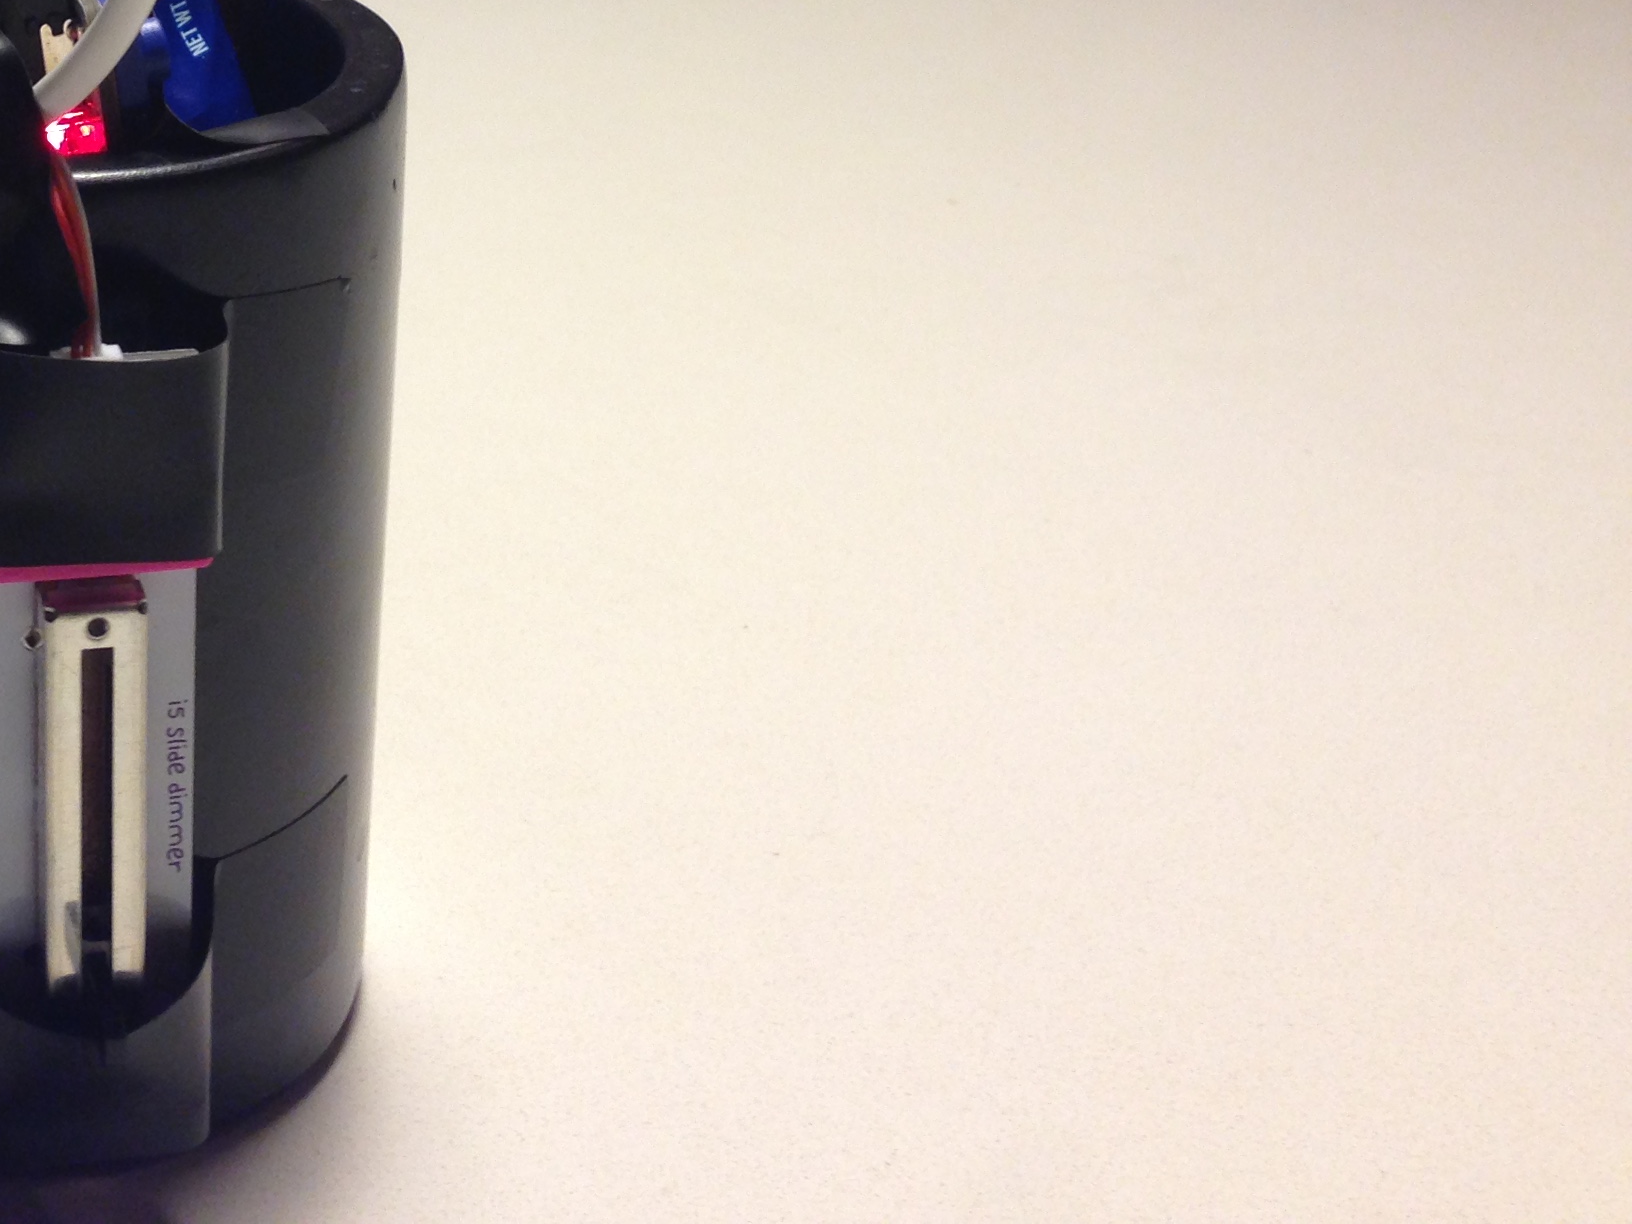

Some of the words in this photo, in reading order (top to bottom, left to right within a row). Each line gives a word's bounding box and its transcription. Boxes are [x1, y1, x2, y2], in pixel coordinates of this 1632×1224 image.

[169, 0, 195, 28] WT
[181, 26, 210, 58] NET
[166, 727, 189, 776] slide
[166, 782, 189, 873] dimmer
